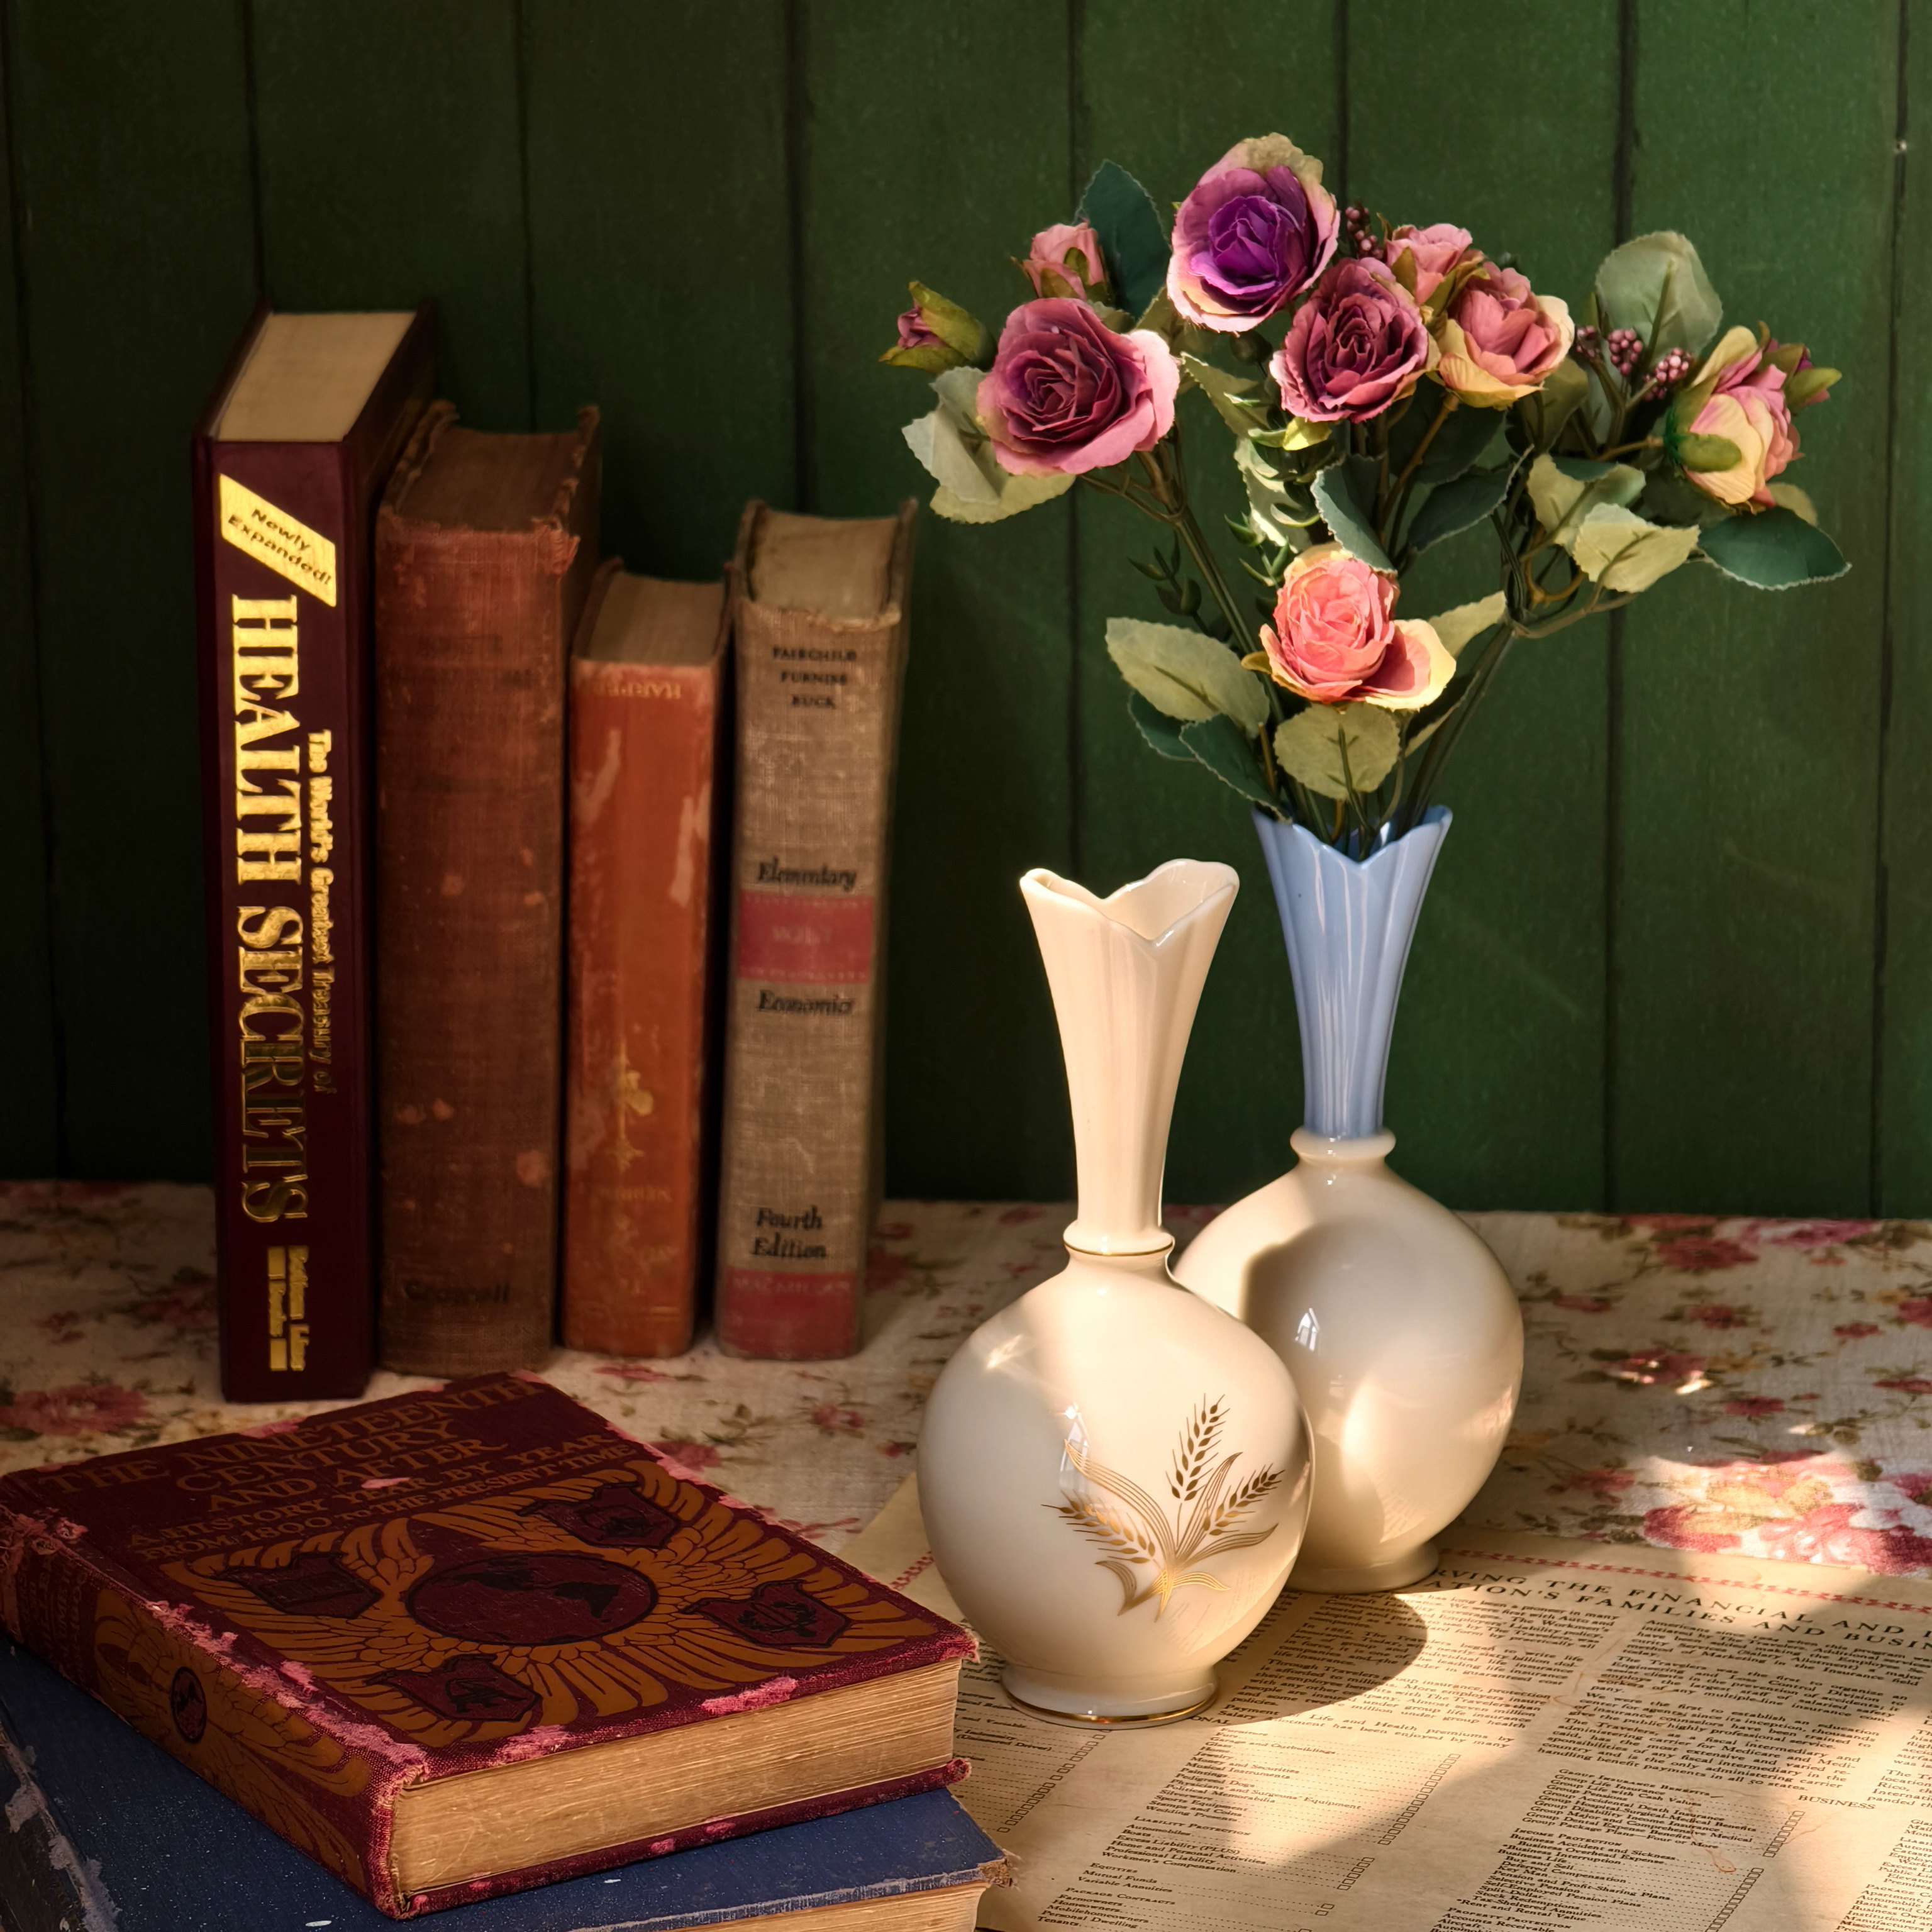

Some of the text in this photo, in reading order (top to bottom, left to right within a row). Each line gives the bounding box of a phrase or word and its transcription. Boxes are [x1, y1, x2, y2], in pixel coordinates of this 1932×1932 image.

[252, 508, 311, 552] Newly
[228, 514, 332, 586] Expanded!
[772, 645, 858, 662] FAIRCHILD
[232, 594, 301, 885] HEALTH
[758, 855, 858, 892] Elementary
[310, 867, 335, 963] Greatest
[308, 965, 335, 1065] Treasury
[238, 906, 308, 1223] SECRETS
[313, 1069, 338, 1094] of
[756, 1204, 823, 1231] Fourth
[751, 1231, 827, 1258] Edition
[44, 1375, 546, 1494] THE NINETEENTH
[176, 1419, 458, 1492] CENTURY
[208, 1438, 508, 1513] AND AFTER
[159, 1498, 333, 1540] HISTORY
[331, 1477, 443, 1506] YEAR
[439, 1460, 497, 1480] BY
[505, 1433, 621, 1465] YEAR
[132, 1446, 641, 1562] FROM 1800 TO THE PRESENT TIME
[1423, 1576, 1560, 1602] ATION'S
[1575, 1595, 1737, 1623] FAMILIES
[1753, 1621, 1826, 1636] AND
[1543, 1579, 1613, 1594] THE
[1626, 1589, 1819, 1621] FINANCIAL
[1831, 1619, 1906, 1635] AND
[1267, 1659, 1380, 1678] Through Travelers
[1557, 1724, 1644, 1740] administering
[1649, 1736, 1691, 1745] carrier
[1721, 1746, 1782, 1757] Medicare
[1194, 1752, 1234, 1760] Jewelry
[1536, 1748, 1594, 1760] handling
[1596, 1757, 1640, 1767] benefit
[1643, 1765, 1706, 1776] payments
[1180, 1768, 1228, 1777] Paintings
[1229, 1768, 1290, 1779] Instruments
[1159, 1790, 1214, 1800] Silverware
[1165, 1785, 1275, 1802] Political Memorabilia
[1877, 1782, 1911, 1790] Rico,
[1191, 1801, 1248, 1811] Equipment
[1579, 1796, 1634, 1807] Accidental
[1674, 1811, 1726, 1821] Insurance
[1797, 1795, 1877, 1810] BUSINESS
[1145, 1806, 1237, 1821] Wedding Presents
[1533, 1801, 1721, 1831] Group Disability Income Insurance
[1127, 1824, 1191, 1835] Automobiles
[1521, 1818, 1555, 1826] Group
[1558, 1823, 1602, 1831] Package
[1566, 1812, 1601, 1820] Major
[1625, 1821, 1707, 1835] Comprehensive
[1710, 1833, 1752, 1841] Medical
[1106, 1846, 1216, 1863] Professional Liability
[1152, 1840, 1198, 1849] Liability
[1199, 1846, 1240, 1855] (PLUS)
[1169, 1848, 1212, 1857] Personal
[1216, 1855, 1267, 1863] Activities
[1509, 1834, 1555, 1843] Business
[1558, 1841, 1605, 1850] Accident
[1631, 1851, 1676, 1860] Sickness
[1101, 1852, 1236, 1873] Workmen's Compensation
[1501, 1862, 1628, 1882] Deferred Compensation
[1077, 1877, 1172, 1892] Variable Annuities
[1479, 1886, 1544, 1897] Split-Dollar
[1492, 1871, 1535, 1880] Pension
[1560, 1882, 1638, 1896] Profit-Sharing
[1052, 1900, 1121, 1911] Homeowners
[1058, 1895, 1123, 1906] Farmowners
[1471, 1896, 1602, 1917] Tax-Sheltered Annuities
[1509, 1896, 1581, 1909] Redemptions
[1566, 1893, 1608, 1902] Pension
[1036, 1917, 1079, 1926] Tenants
[1041, 1911, 1139, 1928] Personal Dwelling
[1046, 1905, 1150, 1923] Mobilehomeowners
[1442, 1914, 1492, 1923] Accounts
[1842, 1916, 1926, 1930] Manufacturers
[1847, 1911, 1916, 1923] Institutional
[1437, 1919, 1482, 1928] Aircraft
